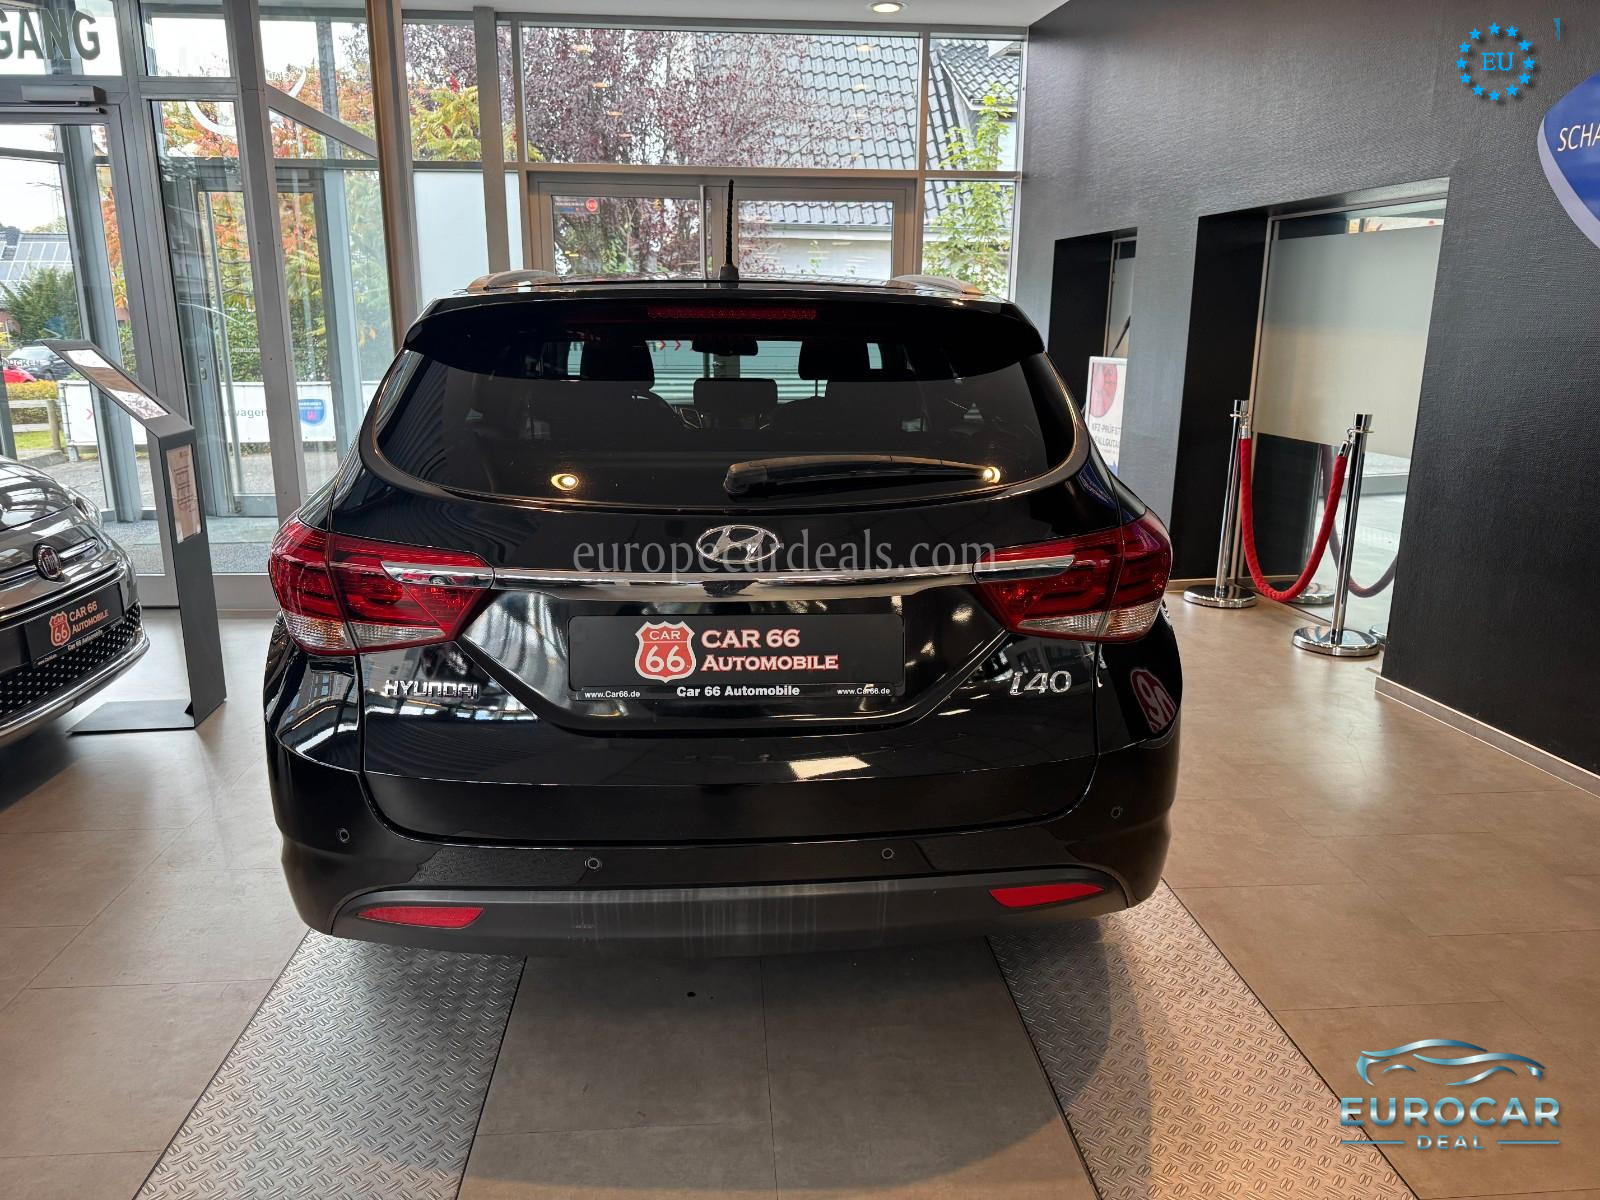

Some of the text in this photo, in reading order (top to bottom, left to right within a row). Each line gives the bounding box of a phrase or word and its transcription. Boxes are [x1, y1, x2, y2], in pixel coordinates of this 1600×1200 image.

[1557, 122, 1600, 151] SCHA
[69, 601, 98, 621] CAR 66
[55, 625, 68, 641] 66
[649, 630, 681, 641] CAR
[701, 628, 801, 649] CAR 66
[645, 645, 686, 673] 66
[384, 680, 478, 697] HYUNDAI
[584, 690, 640, 698] www.Car66.de
[676, 684, 800, 697] Car 66 Automobile
